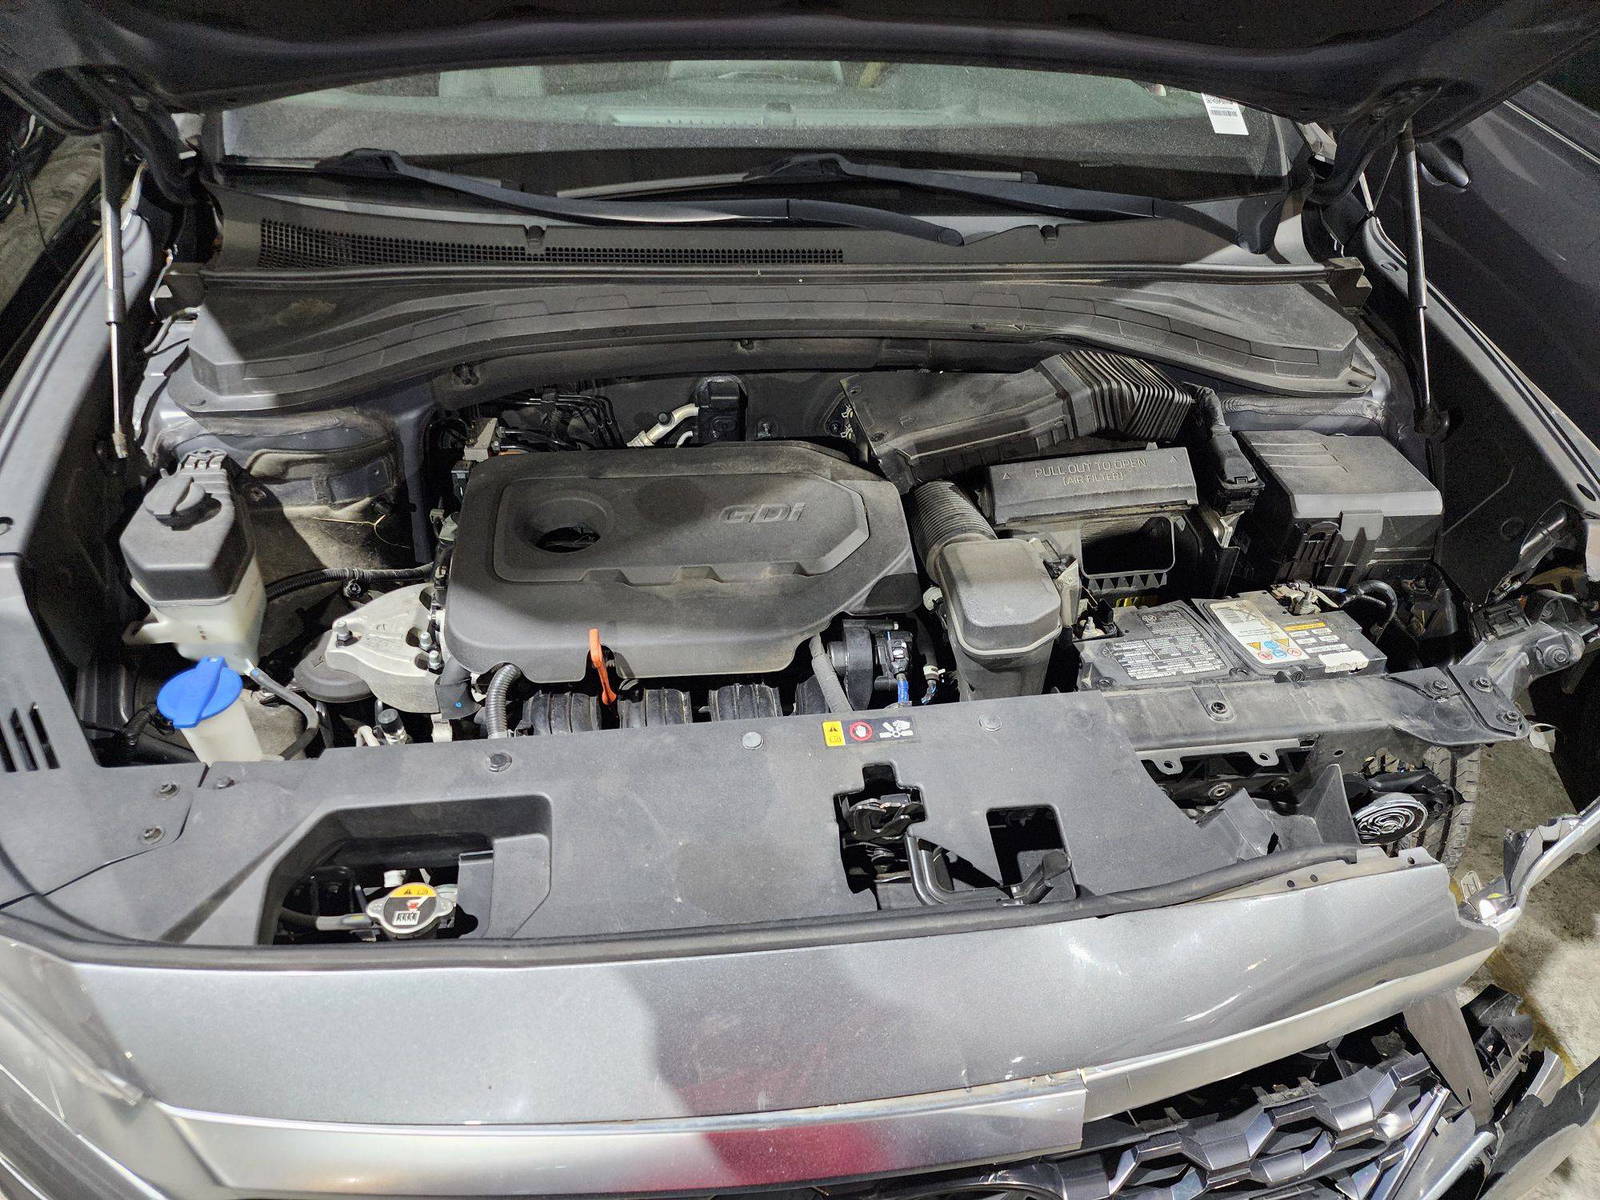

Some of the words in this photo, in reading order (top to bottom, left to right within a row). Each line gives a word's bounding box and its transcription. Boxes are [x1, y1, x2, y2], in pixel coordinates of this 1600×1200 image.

[1035, 463, 1066, 478] PULL
[1067, 462, 1092, 474] OUT
[1095, 461, 1112, 471] TO
[1113, 457, 1148, 470] OPEN
